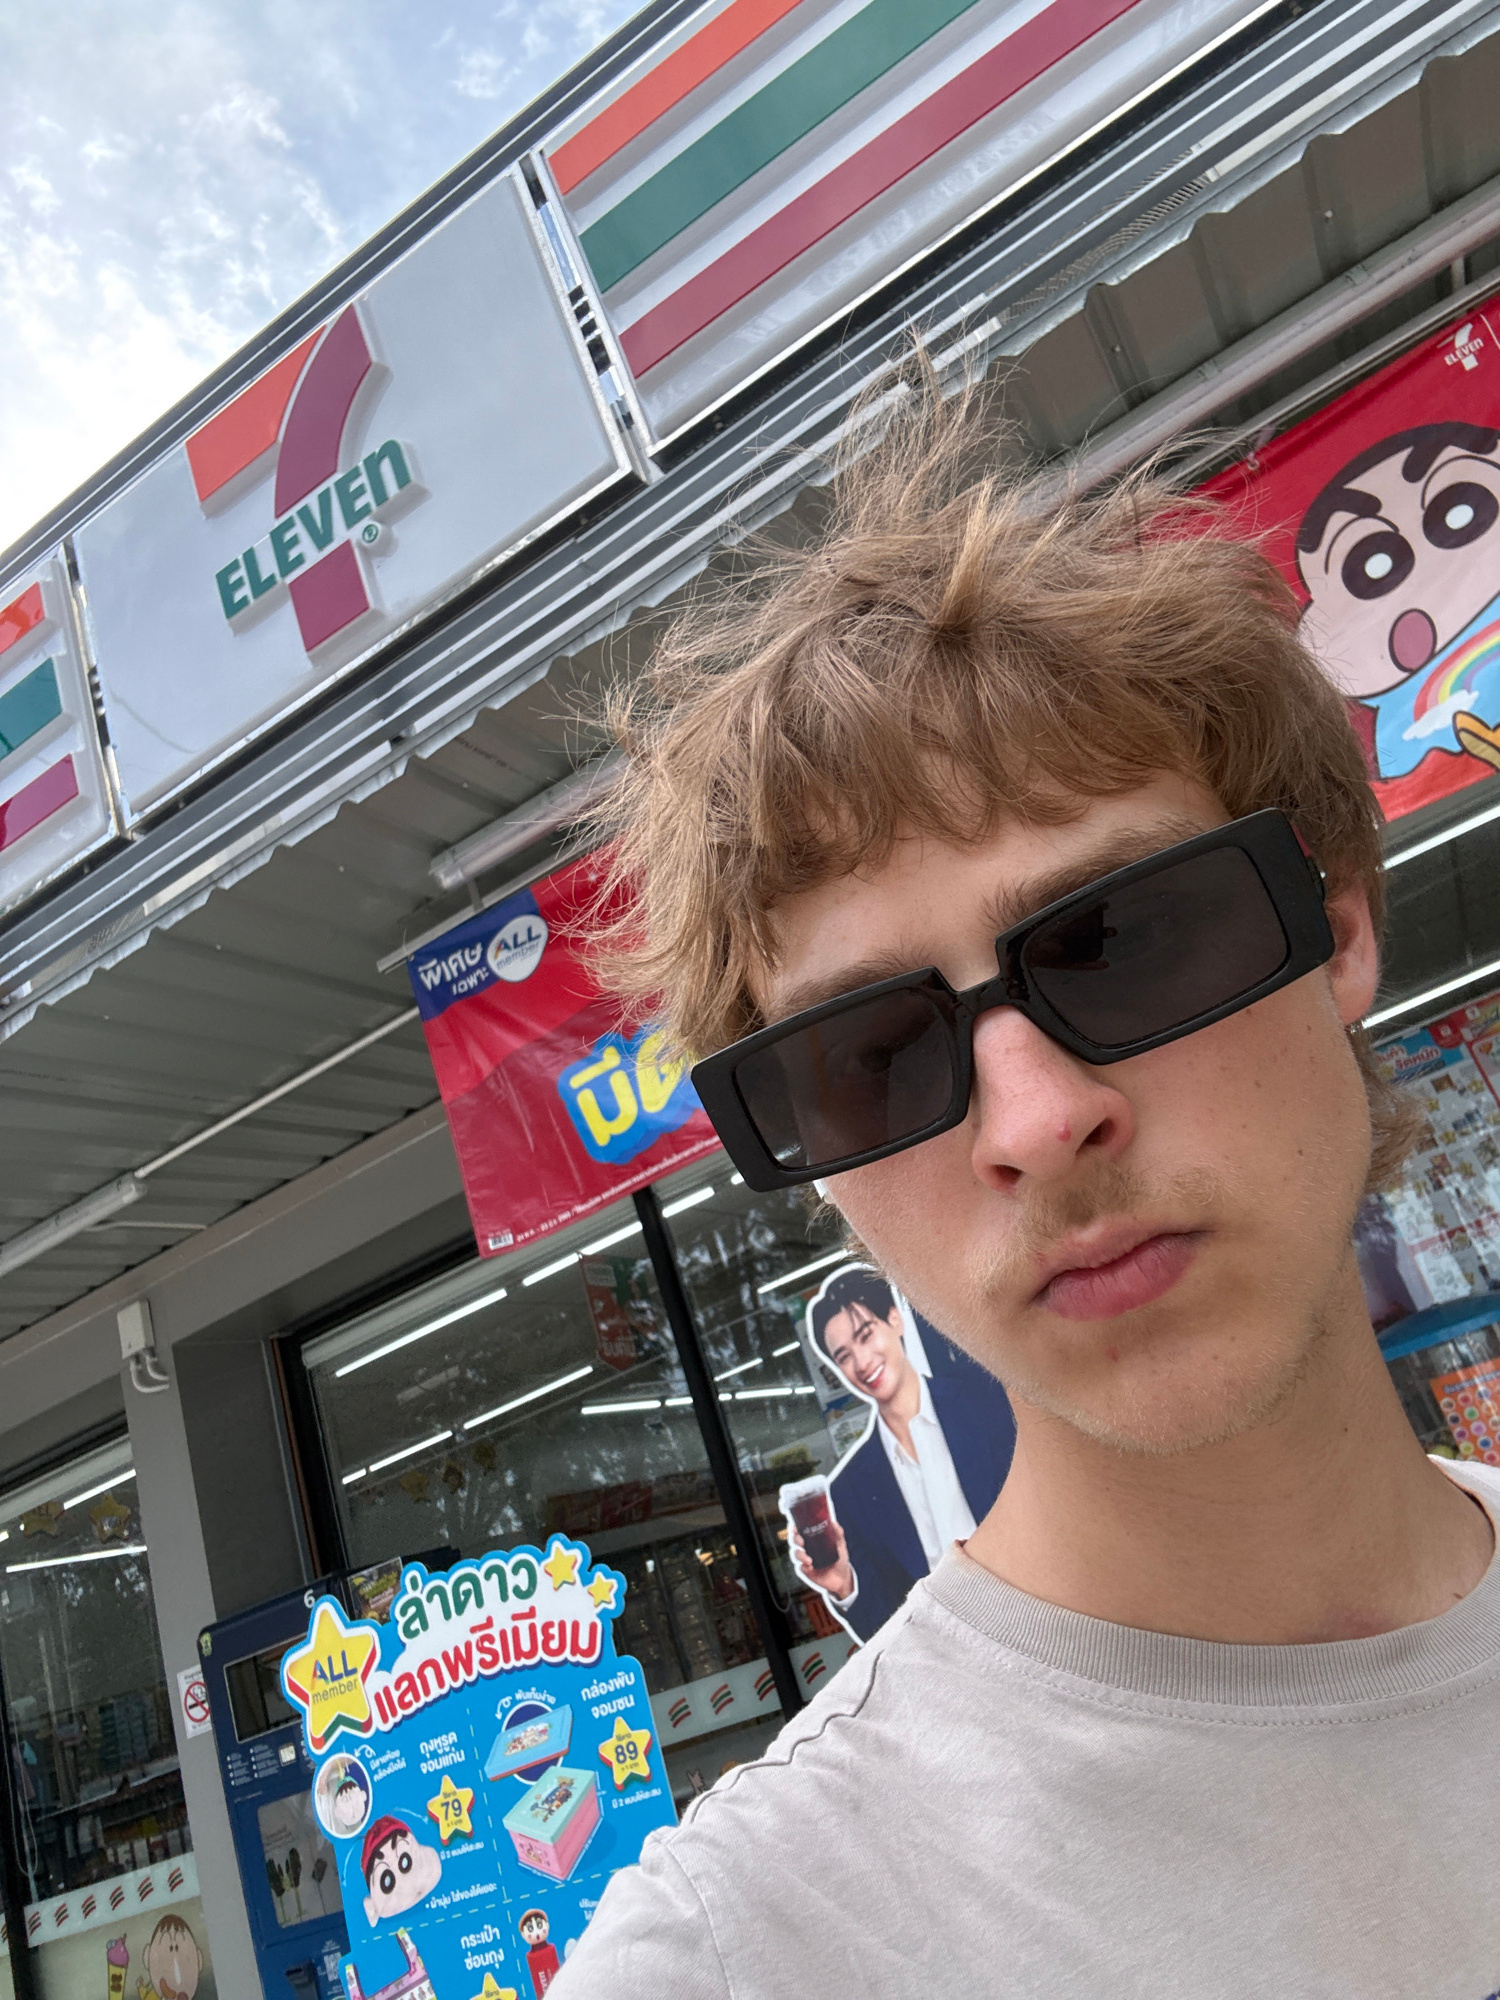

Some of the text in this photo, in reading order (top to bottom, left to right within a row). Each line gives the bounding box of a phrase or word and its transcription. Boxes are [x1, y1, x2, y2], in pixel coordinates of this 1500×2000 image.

[493, 925, 542, 960] ALL
[496, 941, 540, 969] member
[303, 1588, 316, 1609] 6
[399, 1558, 538, 1640] ล่าดาว
[310, 1650, 358, 1690] ALL
[372, 1605, 599, 1726] แลกพรีเมียม
[312, 1679, 360, 1706] member
[580, 1671, 636, 1701] กล่องพับ
[419, 1731, 458, 1759] ถุงหูรูด
[614, 1740, 639, 1764] 89
[419, 1747, 466, 1774] จอมแก่น
[440, 1798, 463, 1821] 79
[460, 1923, 501, 1950] กระเป๋า
